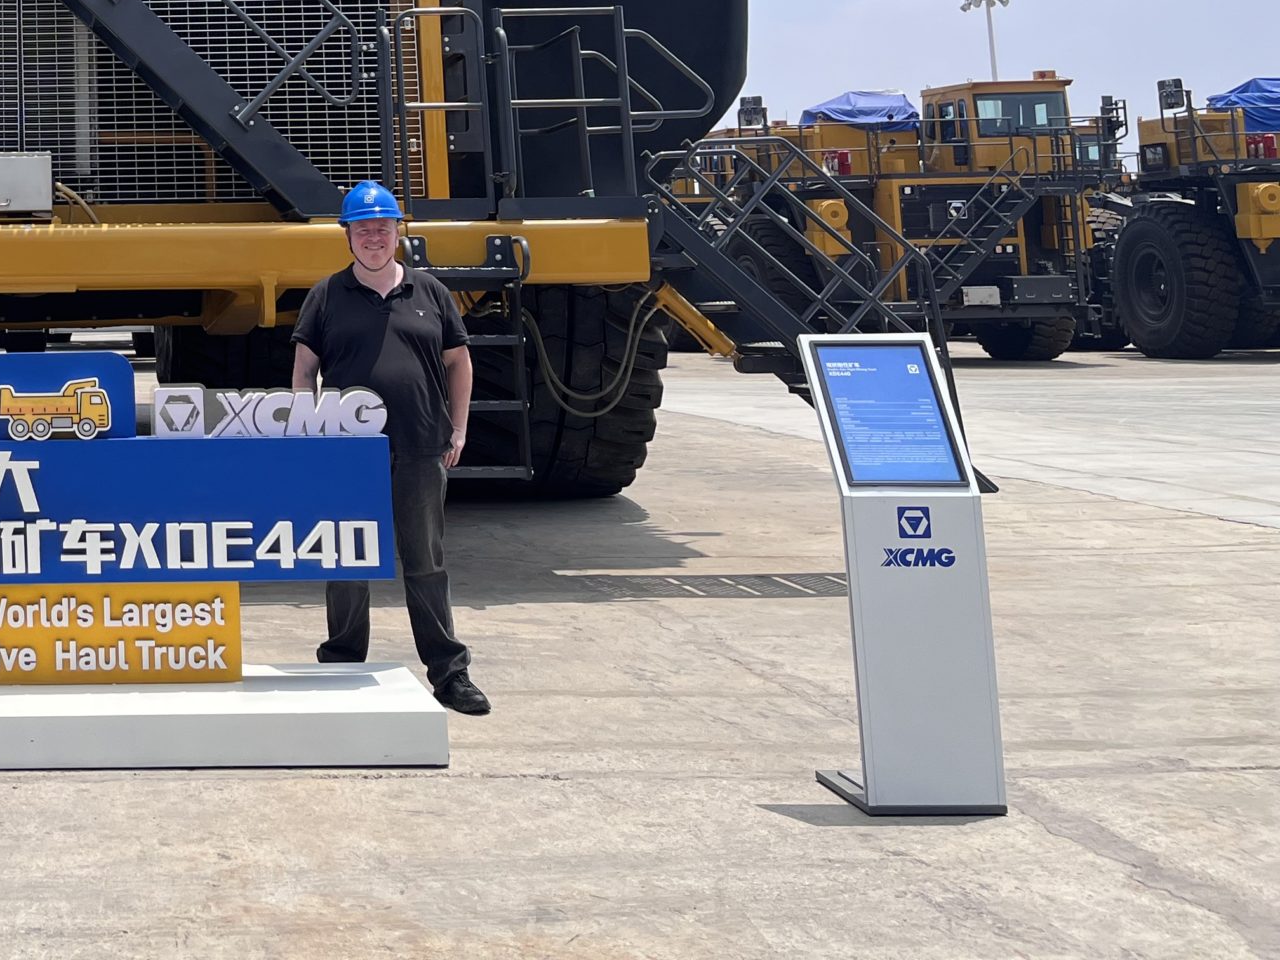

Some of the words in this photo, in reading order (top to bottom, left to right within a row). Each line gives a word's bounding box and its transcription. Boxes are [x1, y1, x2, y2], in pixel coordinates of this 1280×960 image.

[209, 390, 388, 438] XCMG
[880, 547, 956, 567] XCMG
[103, 597, 226, 633] Largest
[55, 640, 129, 671] Haul
[135, 639, 228, 670] Truck
